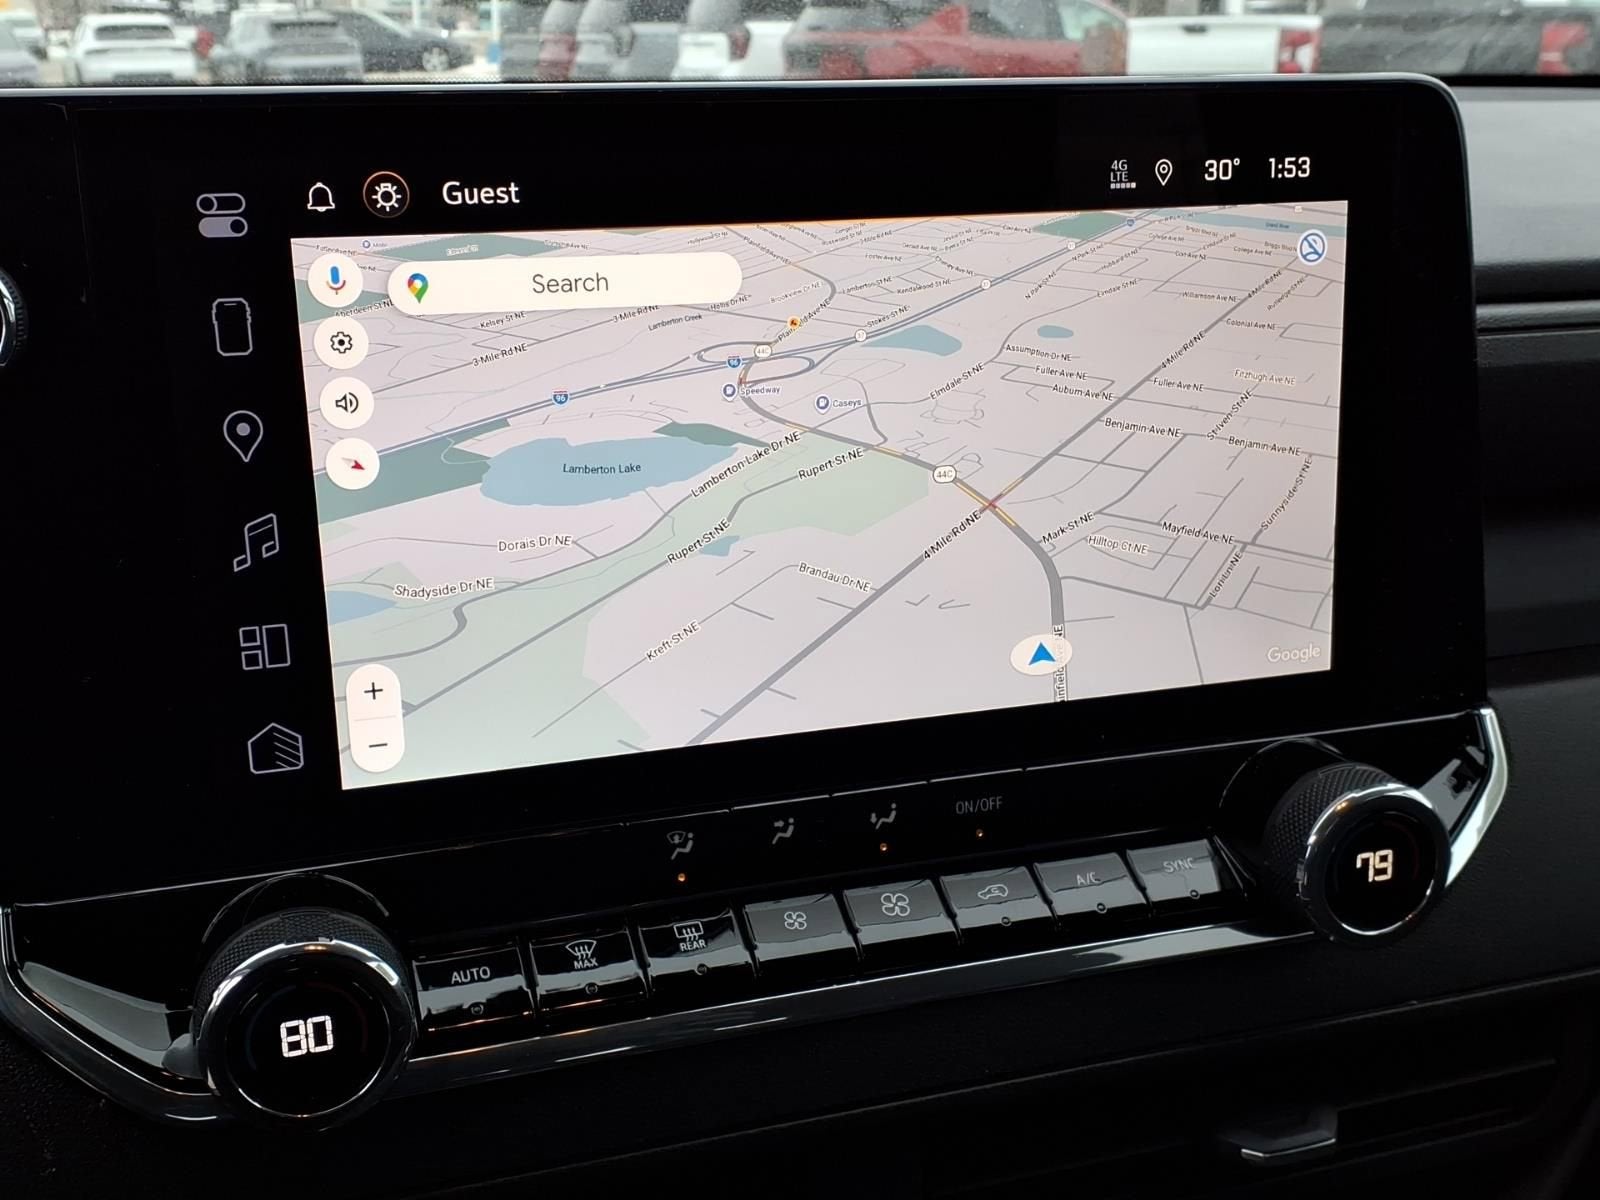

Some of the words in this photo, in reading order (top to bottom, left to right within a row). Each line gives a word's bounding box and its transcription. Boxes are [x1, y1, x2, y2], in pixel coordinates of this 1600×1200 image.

[1110, 159, 1128, 171] 4G
[1268, 156, 1312, 179] 1:53
[1110, 171, 1129, 182] LTE
[441, 181, 521, 205] Guest
[532, 272, 610, 294] Search
[842, 282, 876, 294] Lamberton
[1216, 294, 1228, 302] Ave
[480, 316, 504, 329] Kelsey
[514, 310, 526, 319] NE
[618, 310, 636, 322] Mile
[648, 316, 684, 331] Lamberton
[684, 312, 702, 322] Creek
[866, 313, 890, 328] Stokes
[1226, 318, 1252, 329] Colonial
[1253, 322, 1266, 330] Ave
[472, 358, 480, 368] 3
[480, 352, 500, 365] Mile
[500, 348, 514, 358] Rd
[514, 343, 528, 354] NE
[1005, 344, 1049, 358] Assumption
[1050, 352, 1060, 360] Dr
[1166, 349, 1184, 365] Mile
[1194, 330, 1206, 343] NE
[930, 378, 962, 400] Elmdale
[972, 362, 984, 374] NE
[1036, 365, 1058, 376] Fuller
[1059, 369, 1074, 378] Ave
[1076, 372, 1088, 380] NE
[1269, 374, 1284, 384] Ave
[1284, 377, 1296, 386] NE
[740, 386, 780, 396] Speedway
[1052, 384, 1082, 396] Auburn
[1084, 388, 1101, 399] Ave
[1102, 392, 1114, 401] NE
[1153, 378, 1175, 388] Fuller
[1176, 381, 1192, 390] Ave
[1192, 384, 1204, 392] NE
[832, 398, 862, 408] Caseys
[1104, 417, 1146, 434] Benjamin
[1148, 424, 1166, 436] Ave
[1166, 428, 1181, 438] NE
[1228, 436, 1270, 452] Benjamin
[1270, 442, 1288, 454] Ave
[1288, 446, 1302, 456] NE
[562, 463, 616, 475] Lamberton
[618, 462, 642, 474] Lake
[690, 461, 746, 498] Lamberton
[746, 446, 770, 465] Lake
[770, 438, 784, 452] Dr
[784, 430, 802, 445] NE
[798, 462, 834, 481] Rupert
[834, 454, 848, 468] St
[847, 448, 864, 462] NE
[936, 469, 954, 479] 44C
[1260, 485, 1299, 531] Sunnyside
[1300, 457, 1312, 474] NE
[930, 533, 952, 554] Mile
[952, 522, 968, 538] Rd
[966, 510, 982, 527] NE
[1042, 526, 1066, 544] Mark
[1066, 518, 1080, 531] St
[1080, 511, 1095, 524] NE
[1161, 522, 1202, 538] Mayfield
[1203, 530, 1220, 542] Ave
[1221, 534, 1234, 545] NE
[498, 538, 536, 552] Dorais
[538, 536, 552, 546] Dr
[554, 536, 572, 546] NE
[667, 539, 702, 565] Rupert
[702, 530, 716, 544] St
[714, 518, 731, 535] NE
[1088, 535, 1120, 551] Hilltop
[1120, 541, 1133, 552] Ct
[1133, 543, 1148, 554] NE
[1230, 551, 1243, 566] NE
[798, 562, 840, 582] Brandau
[841, 575, 855, 586] Dr
[855, 578, 871, 593] NE
[394, 584, 457, 600] Shadyside
[460, 582, 474, 592] Dr
[476, 577, 494, 590] NE
[646, 640, 672, 662] Kreft
[671, 630, 685, 644] St
[683, 620, 701, 636] NE
[1267, 643, 1321, 663] Google
[956, 796, 1003, 815] ON/OFF
[1162, 858, 1195, 873] SYNC
[1355, 849, 1393, 883] 79
[1076, 872, 1101, 886] A/C
[680, 940, 706, 952] REAR
[574, 958, 598, 970] MAX
[451, 966, 491, 985] AUTO
[280, 1015, 334, 1058] 80
